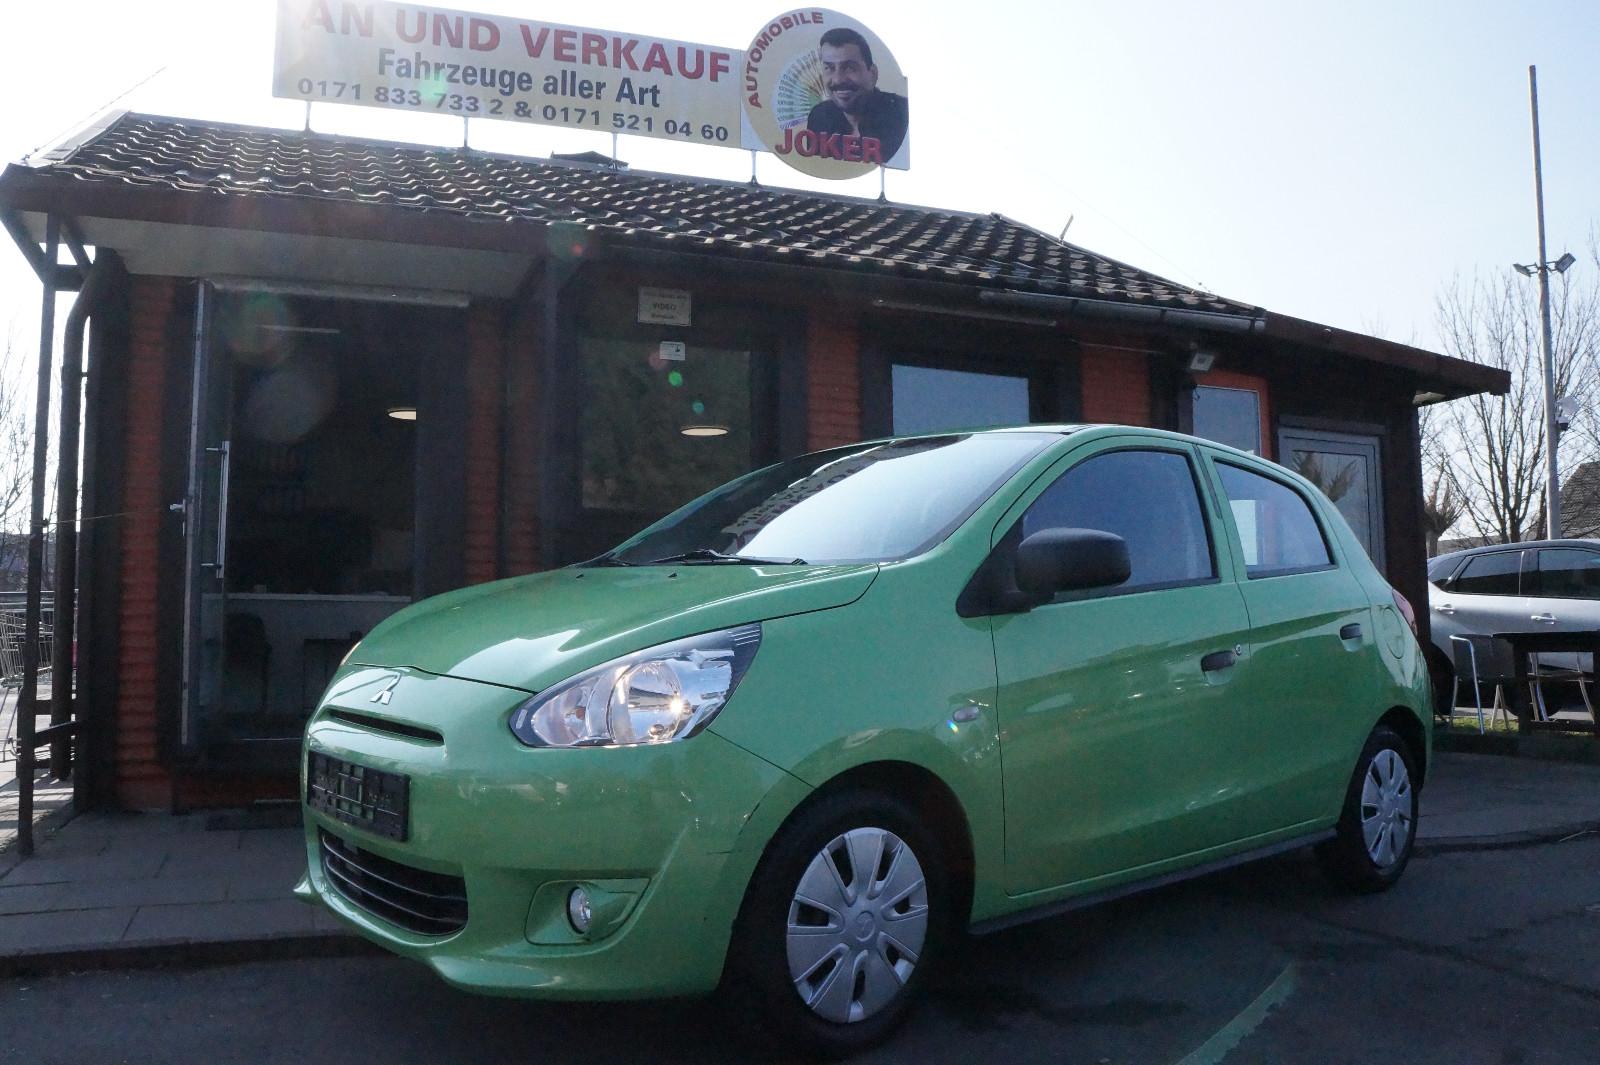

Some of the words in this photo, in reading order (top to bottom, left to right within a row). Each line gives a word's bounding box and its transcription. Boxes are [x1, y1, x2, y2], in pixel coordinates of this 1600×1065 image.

[300, 0, 375, 38] AN
[395, 8, 501, 52] UND
[519, 24, 730, 83] VERKAUF
[745, 11, 824, 109] AUTOMOBILE
[297, 77, 362, 100] 0171
[374, 86, 422, 106] 833
[432, 92, 479, 112] 733
[489, 98, 503, 115] 2
[513, 101, 532, 118] &
[542, 104, 600, 125] 0171
[612, 113, 653, 132] 521
[664, 119, 692, 137] 04
[701, 124, 728, 141] 60
[378, 47, 533, 96] Fahrzeuge
[543, 69, 607, 100] aller
[615, 77, 660, 108] Art
[774, 128, 884, 165] JOKER
